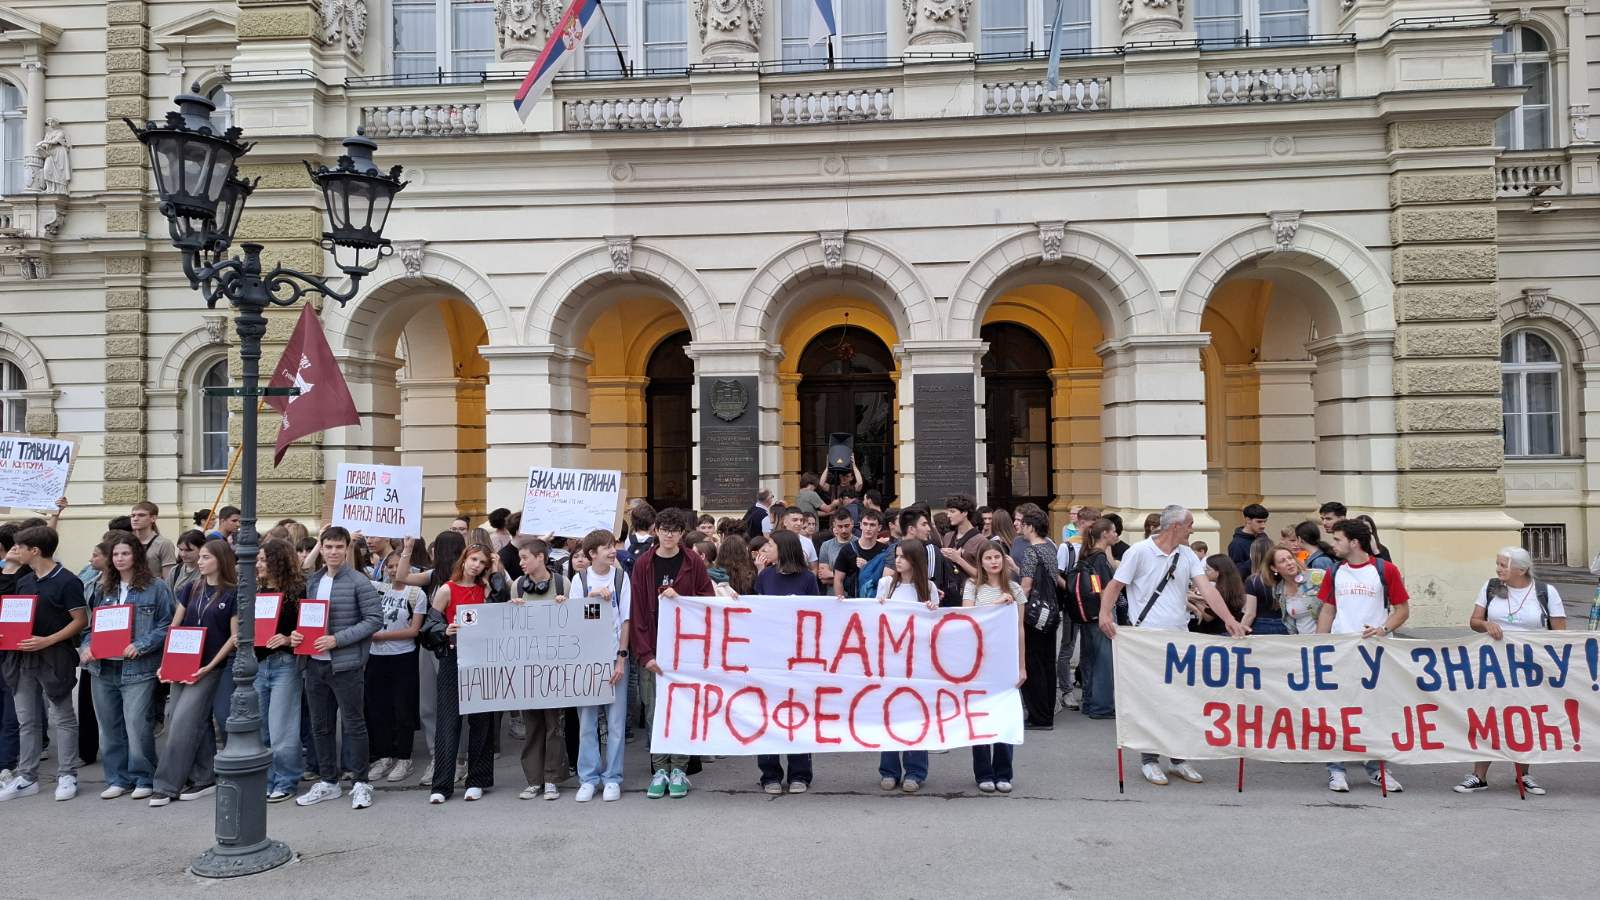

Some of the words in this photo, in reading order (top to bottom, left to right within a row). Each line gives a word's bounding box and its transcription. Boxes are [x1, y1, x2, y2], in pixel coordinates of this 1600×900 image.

[18, 441, 70, 465] ТРАВИЦА
[346, 470, 376, 486] ПРАВДА
[529, 470, 576, 491] БИЉАНА
[577, 472, 617, 493] ПРЛИНА
[383, 488, 399, 503] ЗА
[528, 489, 560, 499] ХЕМИЈА
[342, 503, 373, 522] МАРИЈУ
[375, 506, 405, 525] ВАСИЋ
[502, 605, 536, 631] НИЈЕ
[543, 604, 569, 629] ТО
[485, 635, 541, 662] ШКОЛА
[544, 634, 581, 661] БЕЗ
[672, 606, 752, 672] НЕ
[786, 612, 984, 684] ДАМО
[1164, 642, 1262, 691] МОЋ
[1287, 645, 1339, 692] ЈЕ
[1357, 645, 1385, 690] У
[460, 665, 516, 702] НАШИХ
[523, 662, 615, 700] ПРОФЕСОРА
[664, 682, 998, 748] ПРОФЕСОРЕ
[1202, 701, 1367, 752] ЗНАЊЕ
[1391, 703, 1445, 752] ЈЕ
[1466, 698, 1582, 752] МОЋ!
